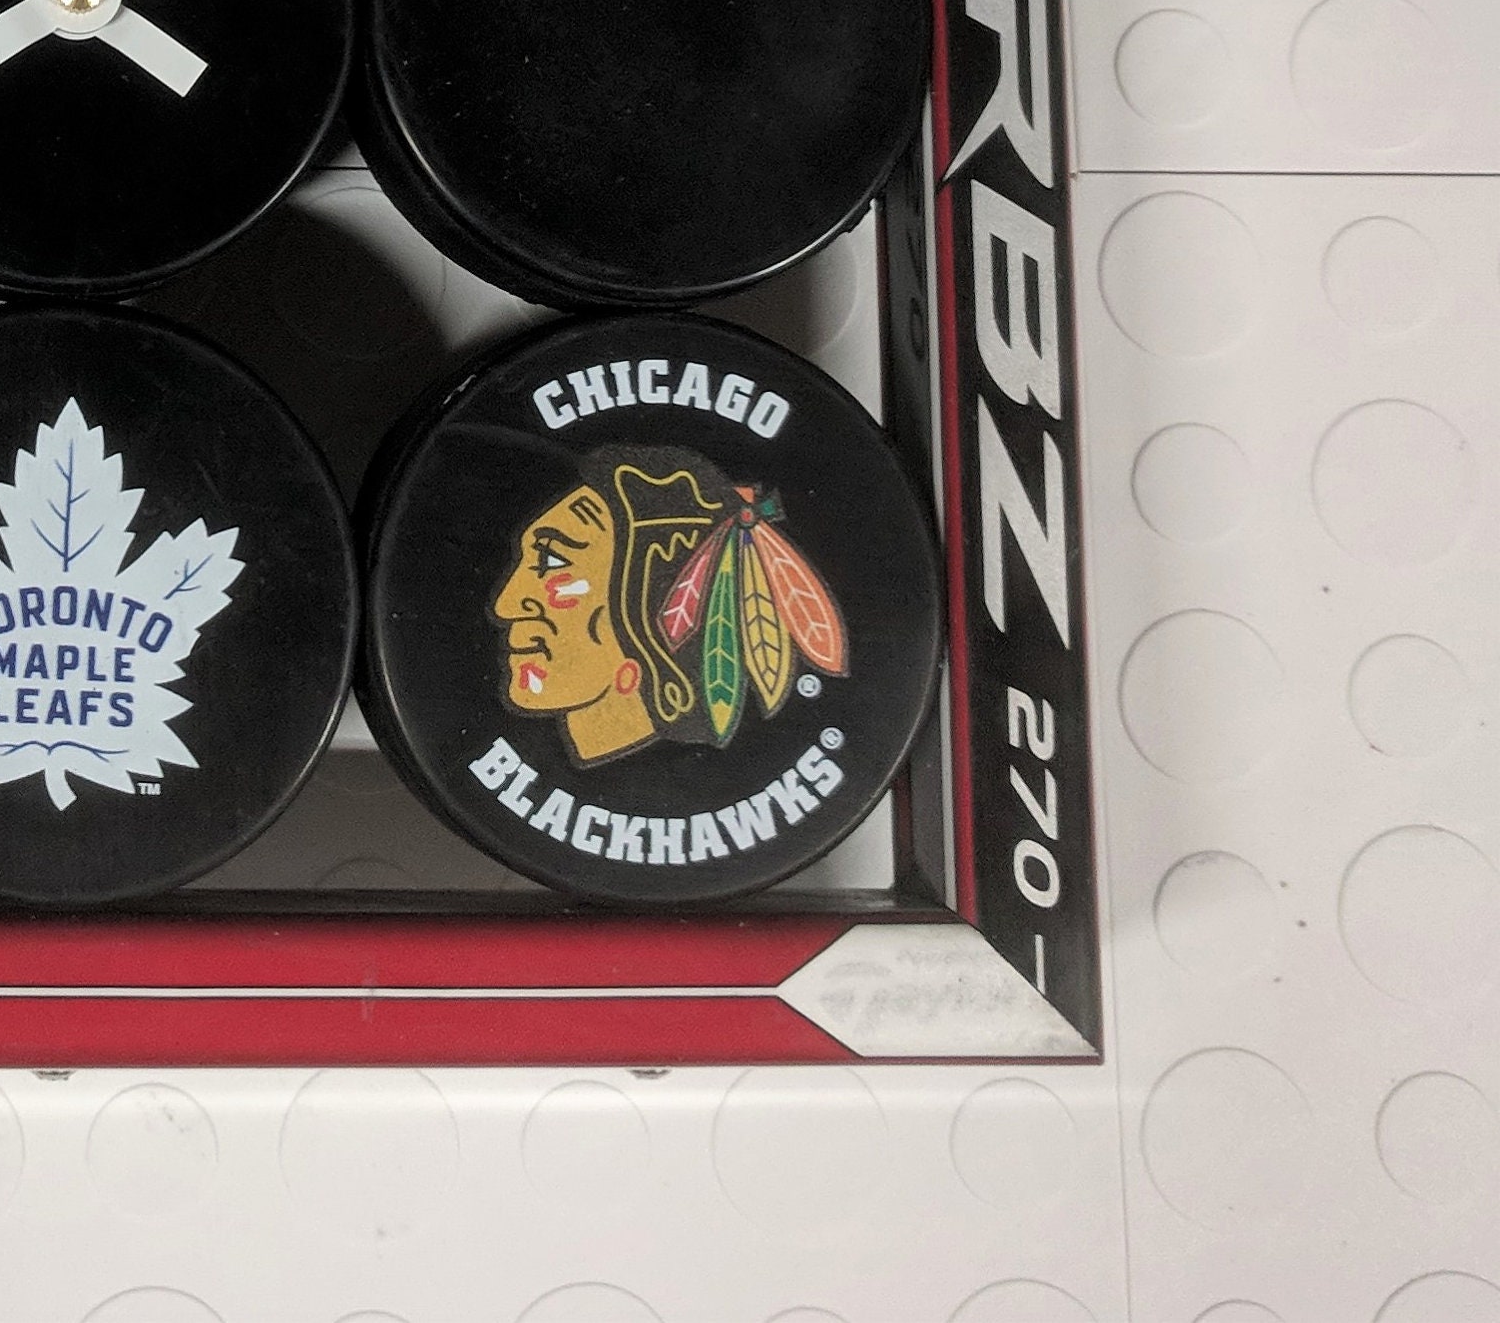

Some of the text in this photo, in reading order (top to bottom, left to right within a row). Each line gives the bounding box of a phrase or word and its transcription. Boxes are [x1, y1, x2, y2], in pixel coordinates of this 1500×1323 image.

[532, 358, 790, 439] CHICAGO
[468, 736, 846, 865] BLACKHAWKS
[1007, 686, 1060, 909] 270
